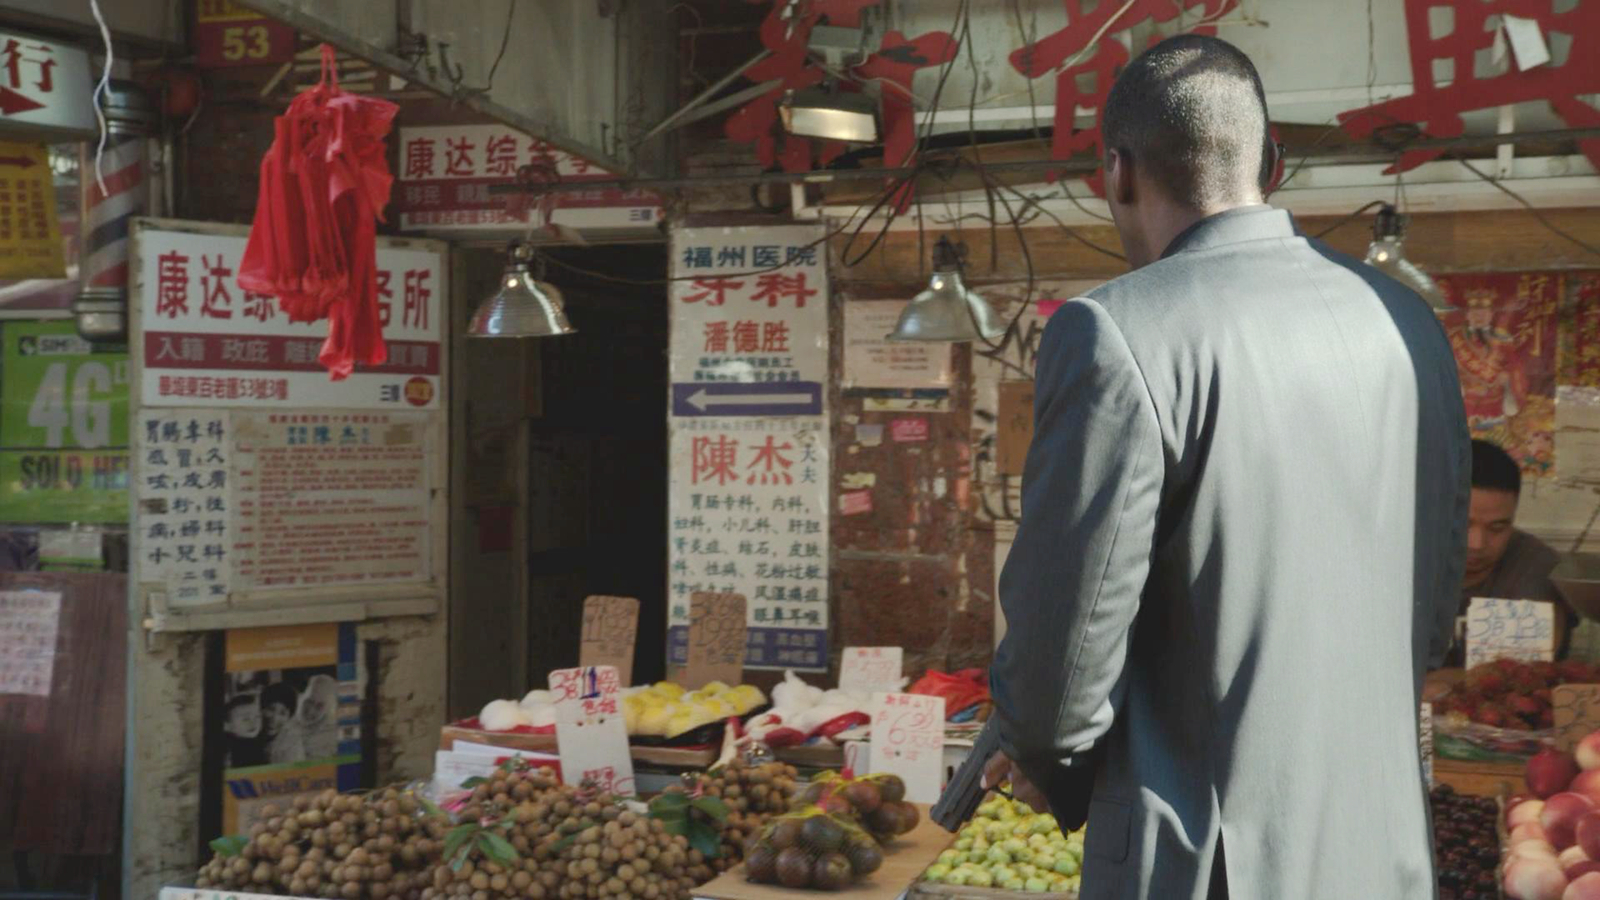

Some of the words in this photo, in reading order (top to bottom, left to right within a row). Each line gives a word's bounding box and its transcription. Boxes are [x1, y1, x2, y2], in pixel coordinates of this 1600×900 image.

[223, 25, 269, 60] 53
[2, 39, 58, 93] 行
[683, 245, 817, 268] 福州医院
[681, 272, 818, 308] 牙科
[703, 320, 791, 354] 潘德胜
[28, 361, 113, 449] 4G
[20, 454, 83, 490] SOLD
[691, 434, 794, 487] 陳杰
